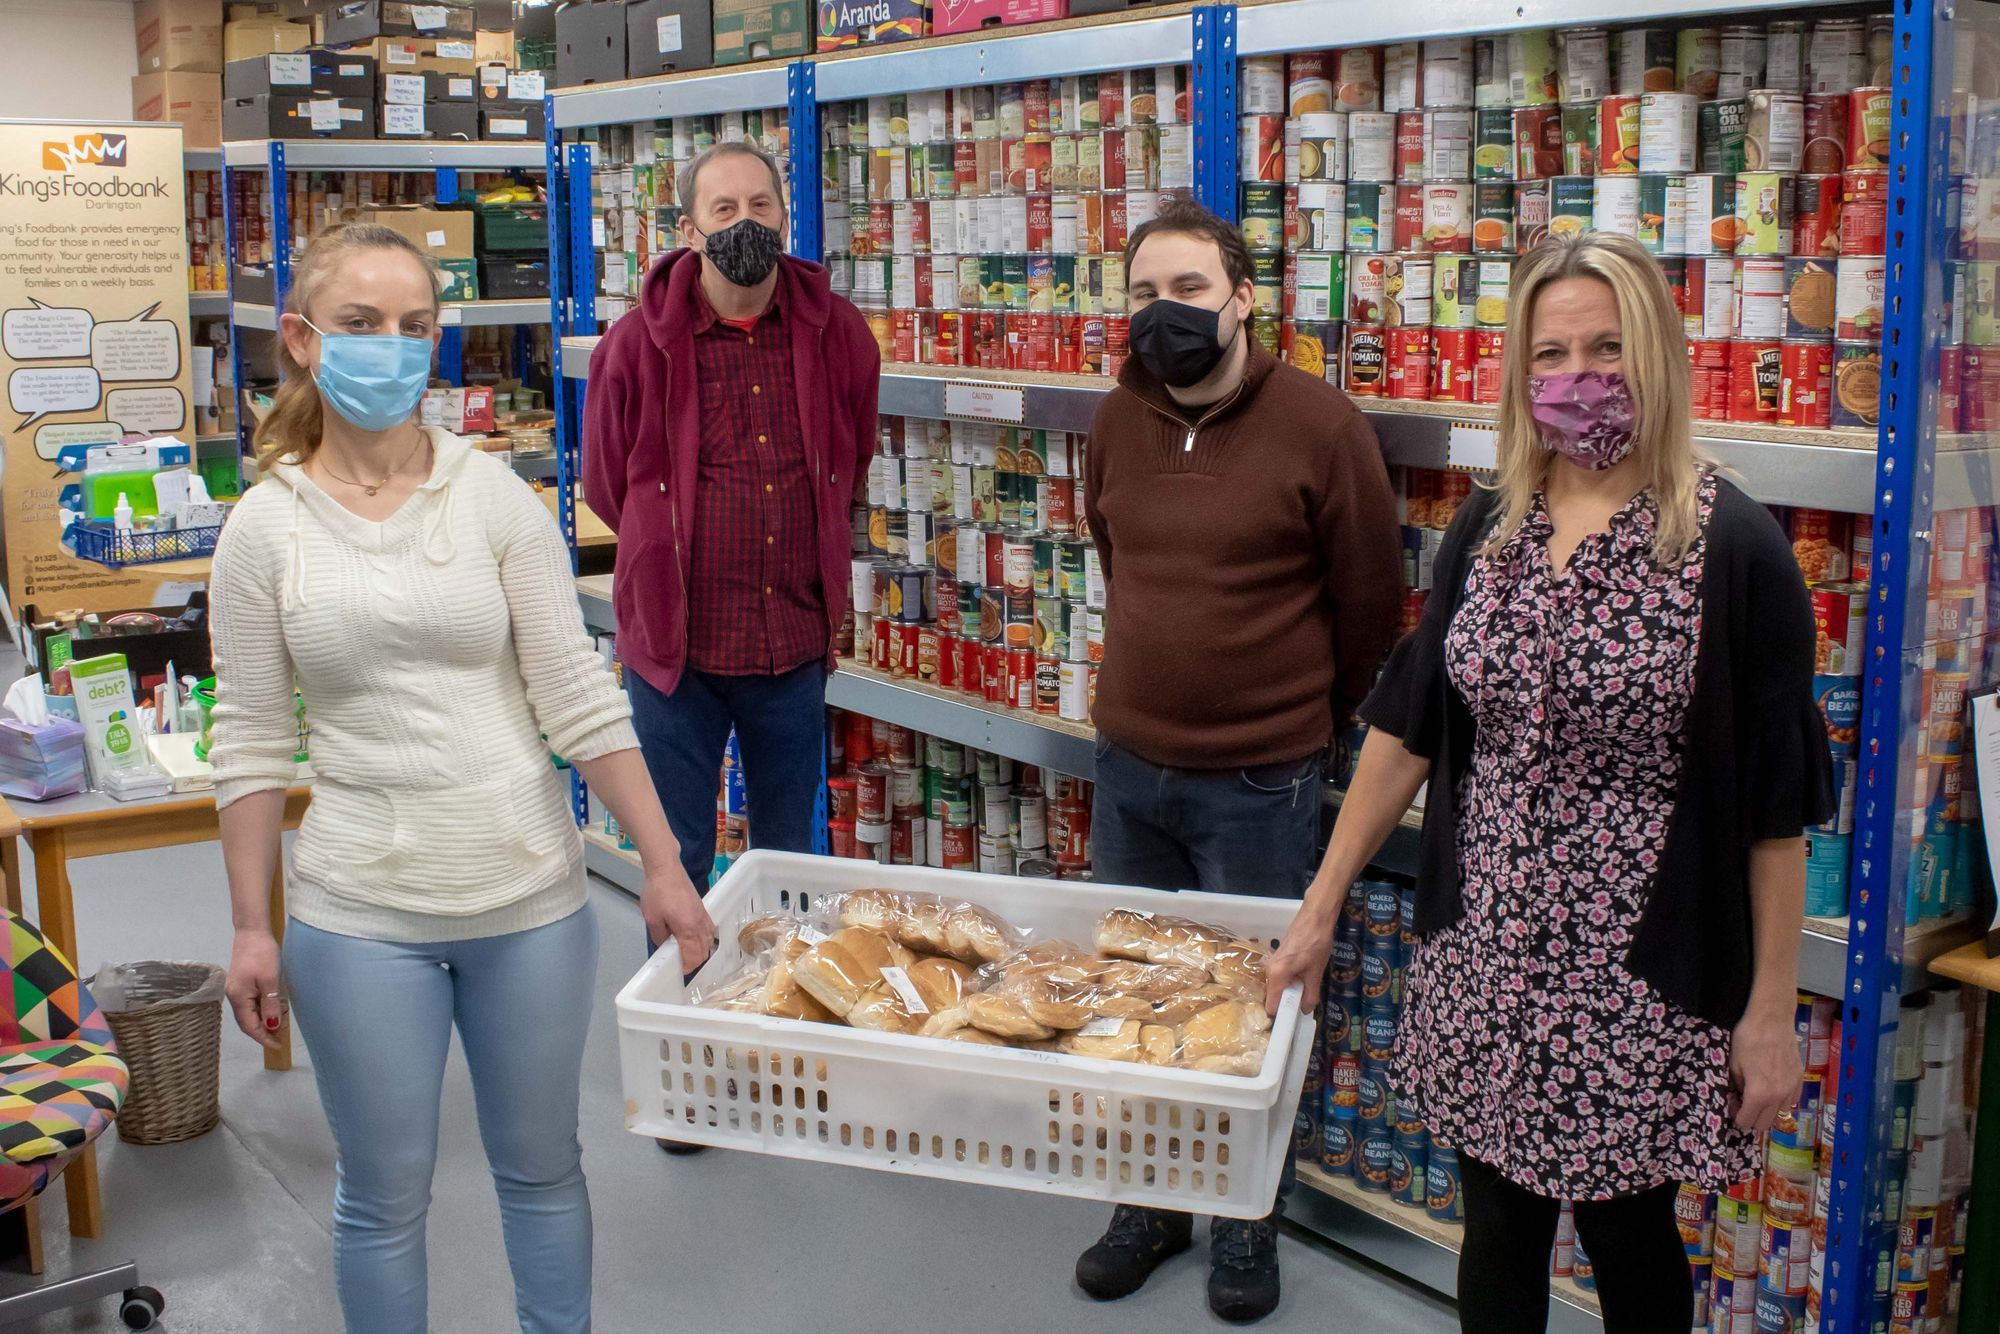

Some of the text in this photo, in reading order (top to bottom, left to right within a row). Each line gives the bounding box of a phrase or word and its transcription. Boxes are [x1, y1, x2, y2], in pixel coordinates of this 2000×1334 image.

[839, 1, 891, 28] Aranda
[1720, 106, 1737, 115] GO
[0, 174, 169, 202] King's Foodbank
[1430, 190, 1458, 199] Baxters
[86, 199, 141, 212] Darlington
[25, 223, 77, 233] Foodbank
[81, 224, 123, 235] provides
[126, 225, 181, 236] emergency
[15, 238, 160, 247] food for those in need in our
[59, 251, 81, 260] Your
[86, 251, 138, 262] generosity
[142, 251, 167, 262] helps
[170, 252, 180, 260] us
[5, 264, 173, 274] to feed vulnerable individuals and
[24, 278, 61, 288] families
[64, 280, 79, 288] on
[81, 280, 88, 288] a
[90, 278, 127, 289] weekly
[1354, 335, 1379, 345] HEINZ
[1352, 352, 1381, 362] TOMATO
[971, 391, 994, 401] CAUTION
[1037, 665, 1059, 674] HEINZ
[88, 680, 126, 700] debt?
[1369, 894, 1394, 903] BAKED
[1367, 903, 1397, 912] BEANS
[1368, 1019, 1393, 1028] BAKED
[1366, 1027, 1396, 1036] BEANS
[1333, 1069, 1360, 1078] BAKED
[1333, 1076, 1360, 1085] BEANS
[1367, 1142, 1392, 1150] BAKED
